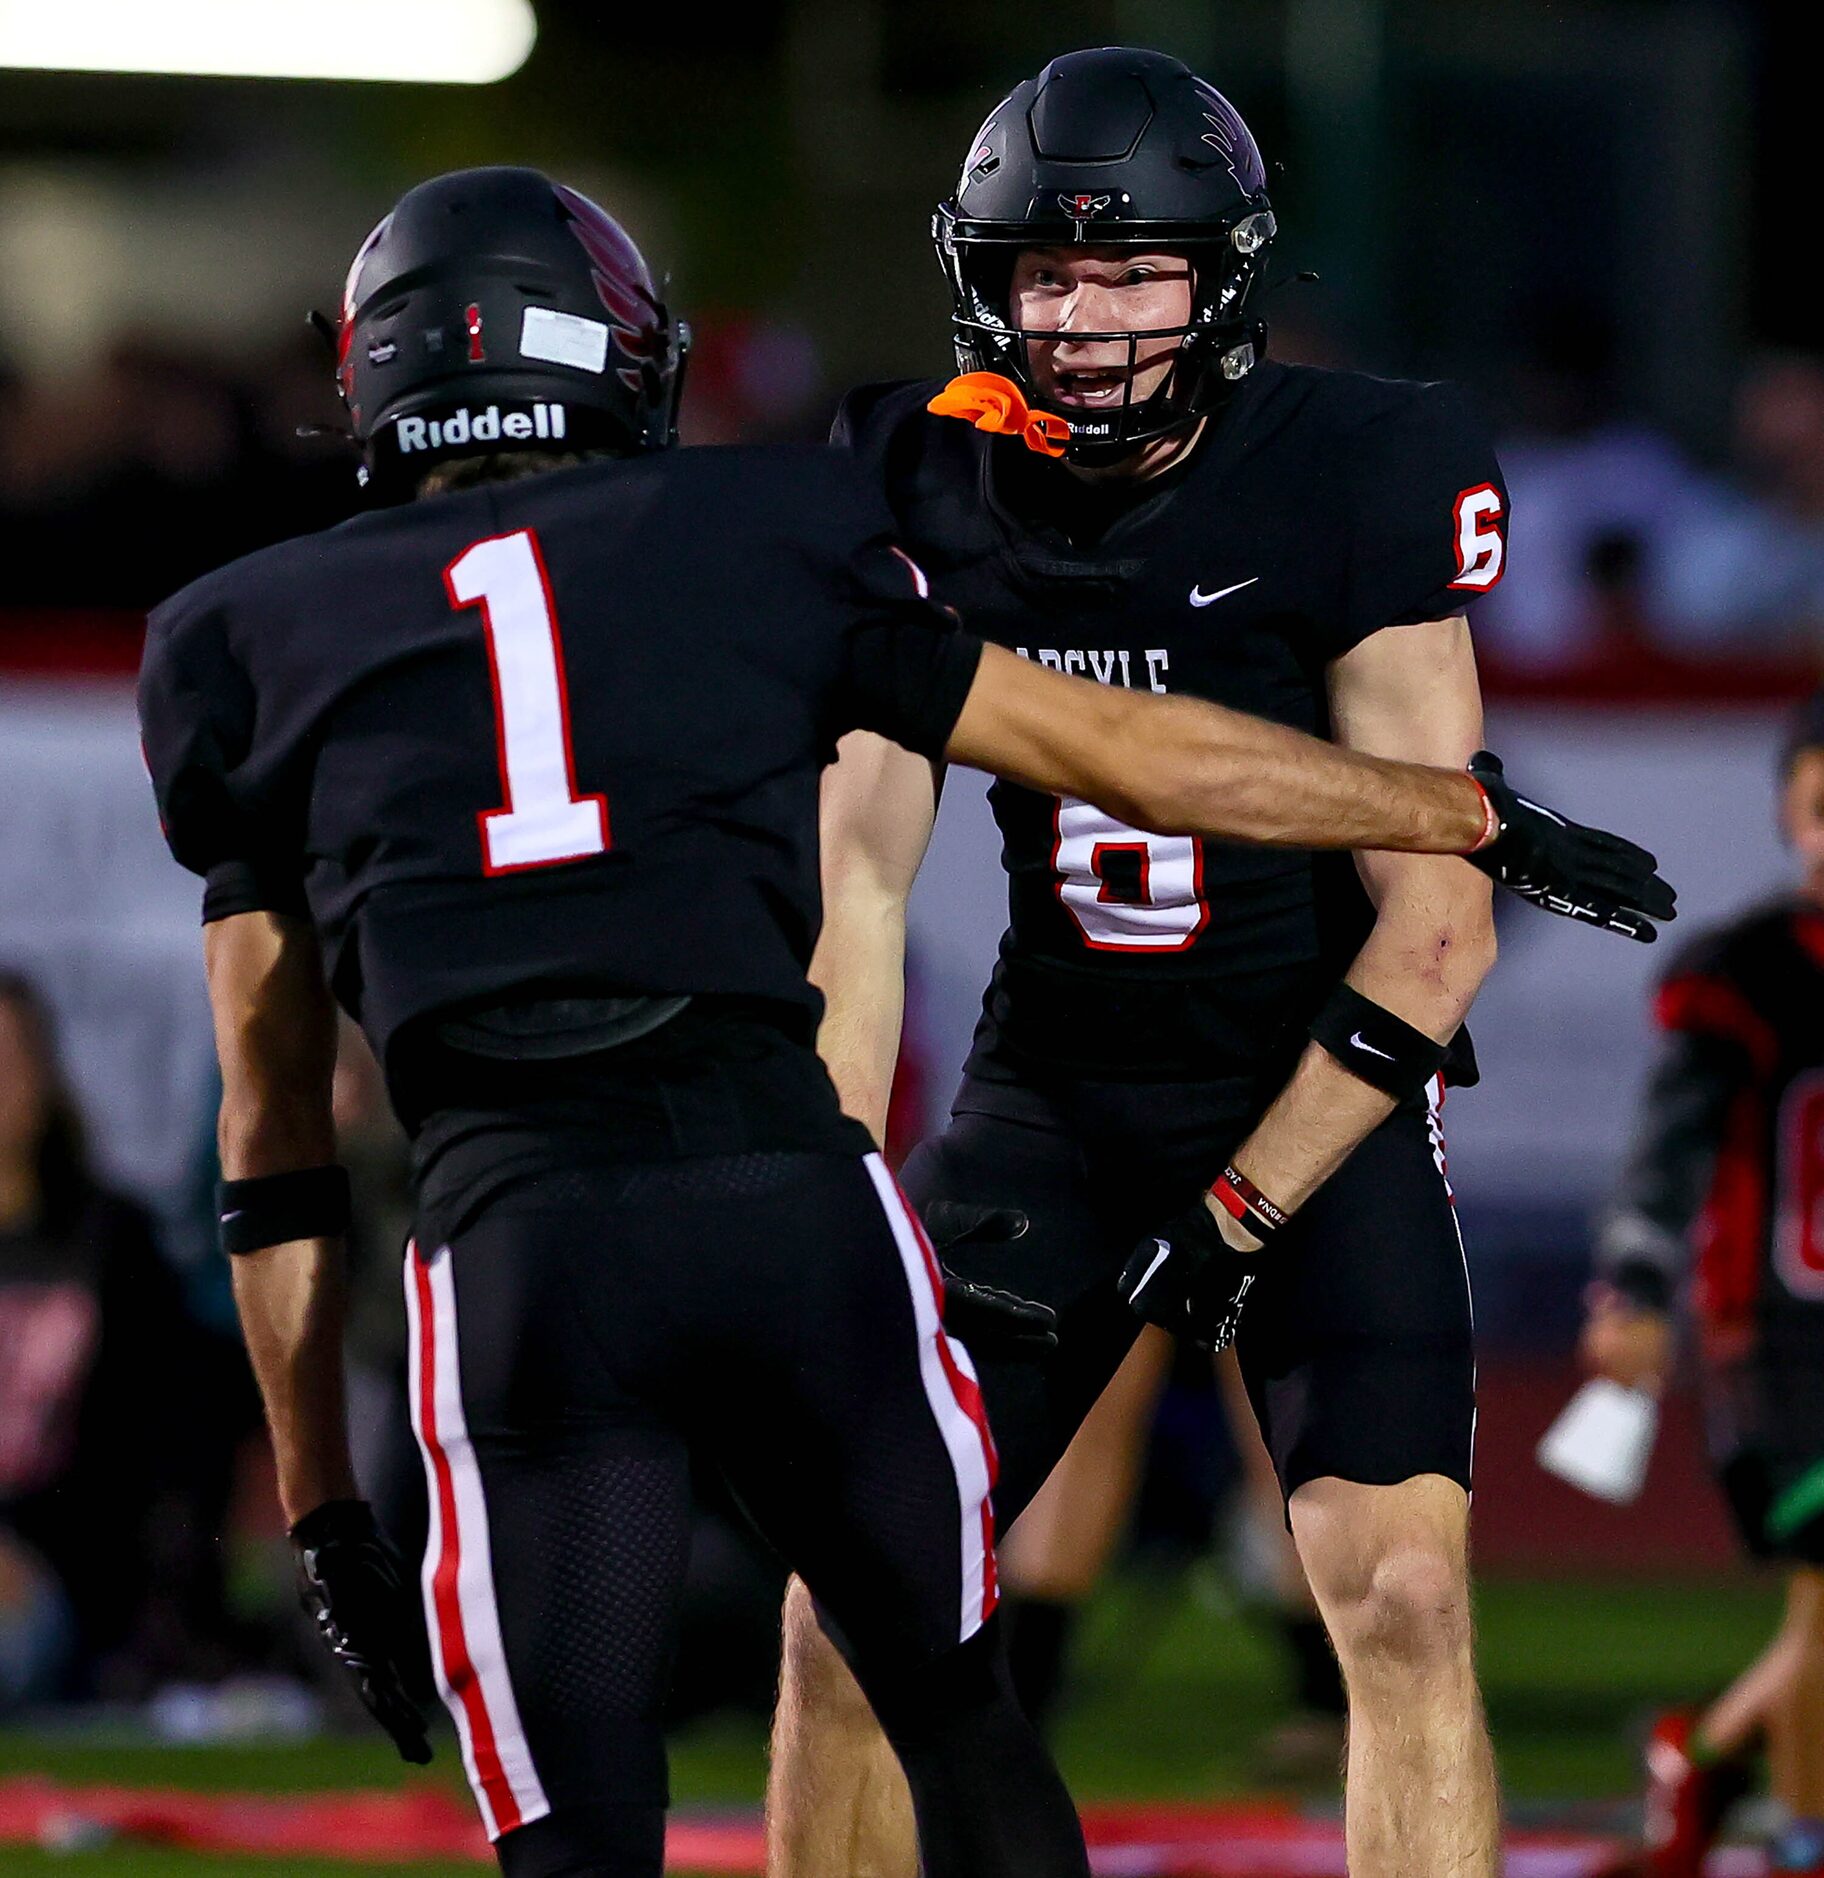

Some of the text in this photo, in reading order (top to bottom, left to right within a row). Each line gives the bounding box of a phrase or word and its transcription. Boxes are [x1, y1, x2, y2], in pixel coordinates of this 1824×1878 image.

[396, 404, 566, 454] Riddell
[1446, 481, 1505, 593] 6
[442, 527, 611, 878] 1
